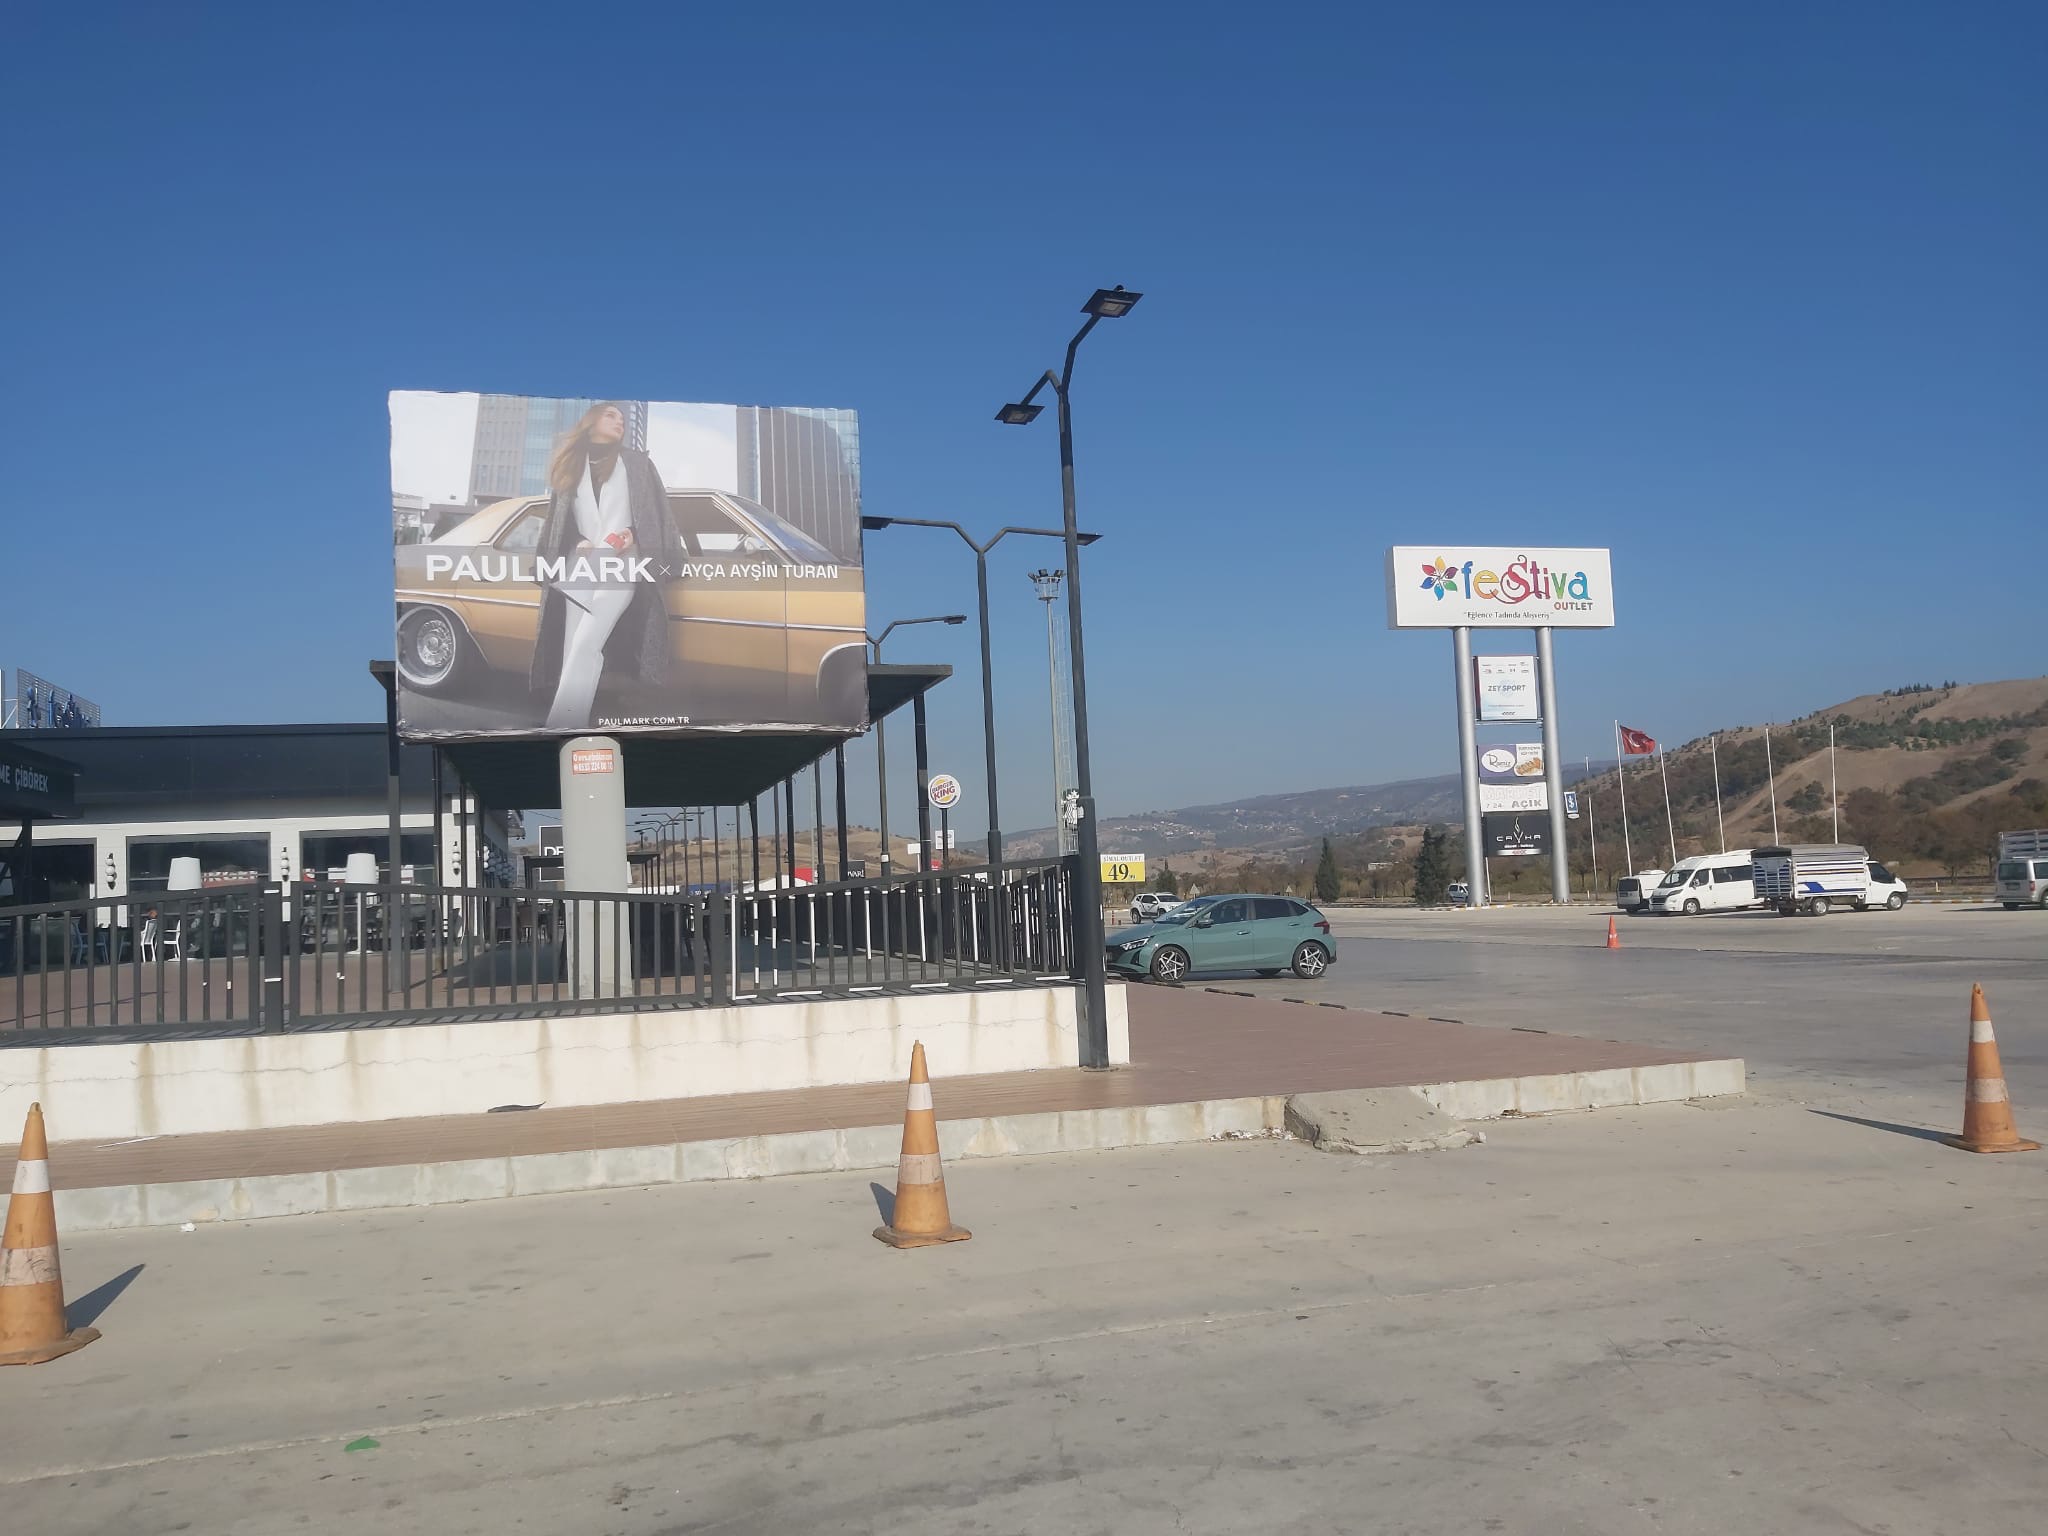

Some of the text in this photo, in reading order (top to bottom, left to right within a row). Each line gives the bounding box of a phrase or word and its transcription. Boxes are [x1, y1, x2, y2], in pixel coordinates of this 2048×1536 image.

[425, 554, 656, 583] PAULMARK
[681, 564, 725, 582] AYÇA
[729, 561, 778, 581] AYŞİN
[782, 563, 839, 580] TURAN
[1553, 601, 1594, 611] OUTLET
[1502, 684, 1526, 693] SPORT
[598, 716, 691, 726] PAULMARK.COM.TR
[15, 764, 48, 793] ÇİBÖREK
[932, 780, 956, 801] BURGER KING
[1511, 799, 1543, 809] AÇIK
[1107, 862, 1129, 881] 49
